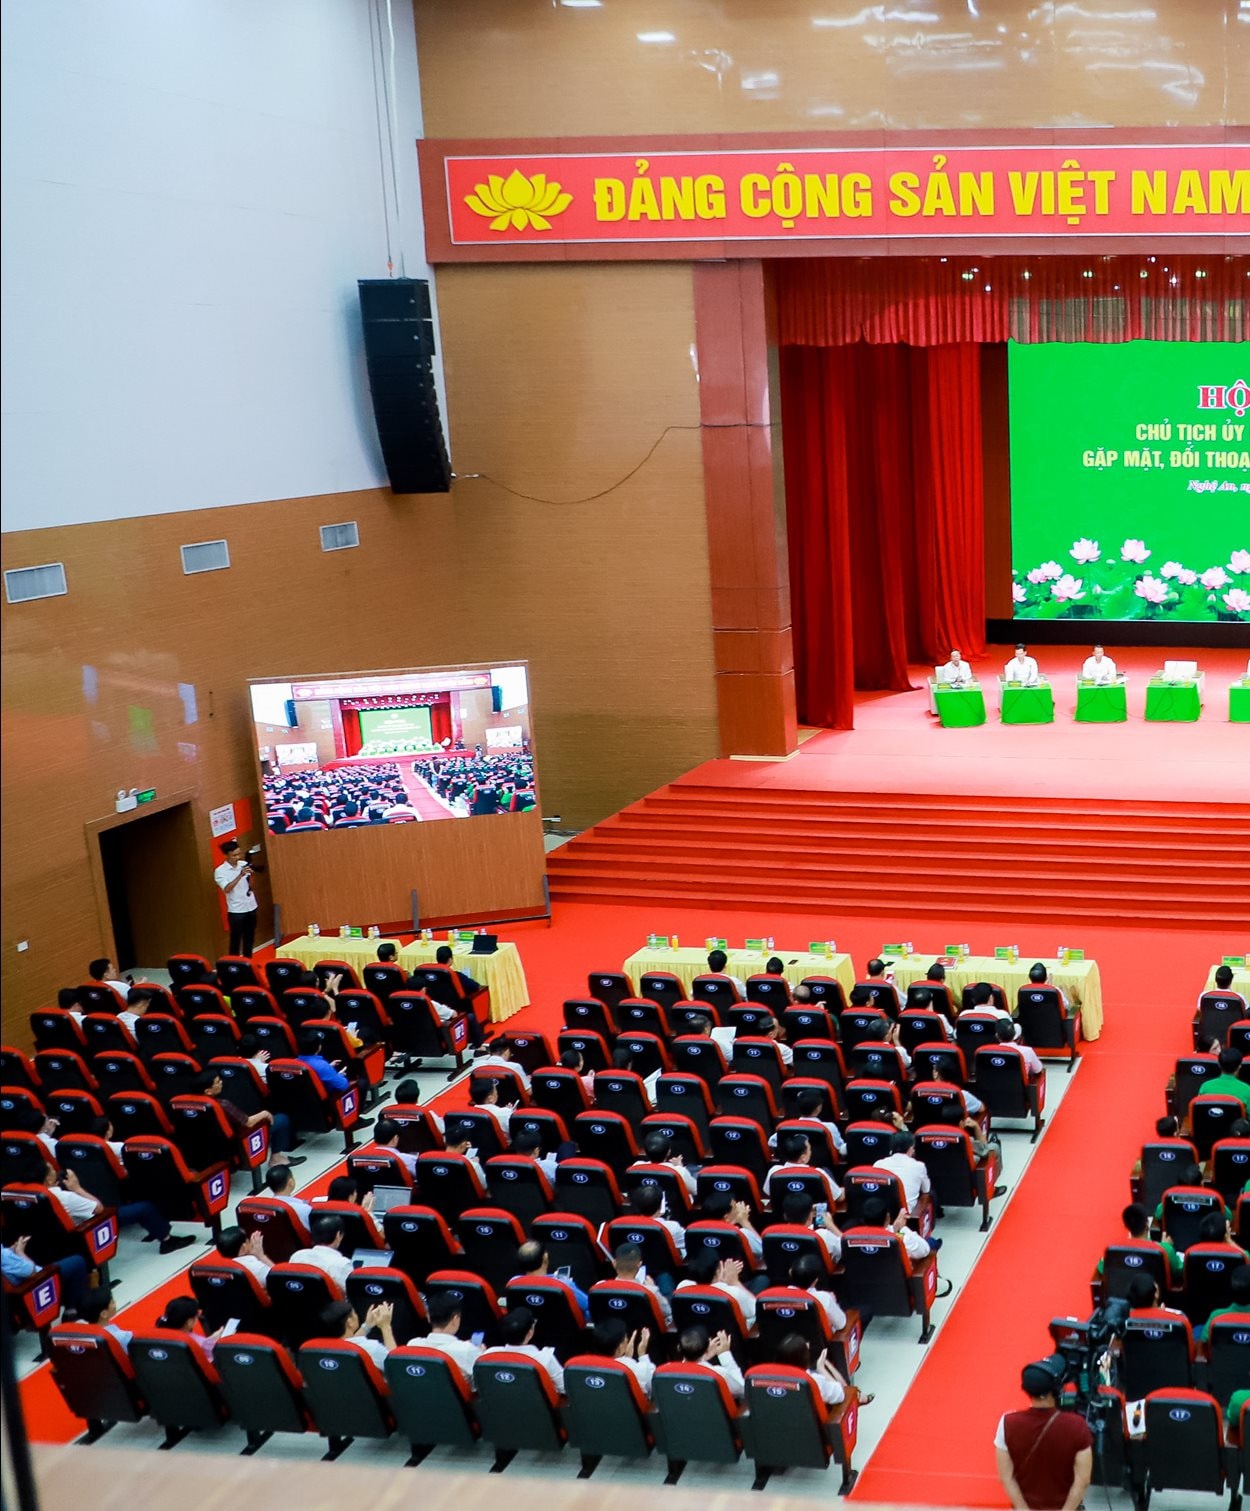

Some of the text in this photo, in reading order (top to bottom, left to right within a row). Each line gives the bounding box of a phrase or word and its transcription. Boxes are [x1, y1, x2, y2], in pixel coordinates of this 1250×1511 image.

[593, 159, 727, 222] ĐẢNG
[740, 163, 873, 228] CỘNG
[889, 154, 995, 217] SẢN
[1008, 158, 1116, 225] VIỆT
[1135, 419, 1171, 441] CHỦ
[1177, 424, 1216, 445] TỊCH
[1222, 419, 1244, 442] ỦY
[1082, 447, 1118, 471] GẶP
[1124, 448, 1164, 471] MẶT,
[1170, 443, 1199, 468] ĐỐI
[344, 1096, 354, 1113] A
[251, 1136, 262, 1154] B
[211, 1178, 222, 1197] C
[97, 1227, 113, 1247] D
[39, 1287, 53, 1308] E
[530, 1296, 540, 1304] 12
[1237, 1334, 1248, 1342] 17
[500, 1373, 510, 1381] 12
[590, 1378, 600, 1386] 13
[1174, 1411, 1185, 1419] 17
